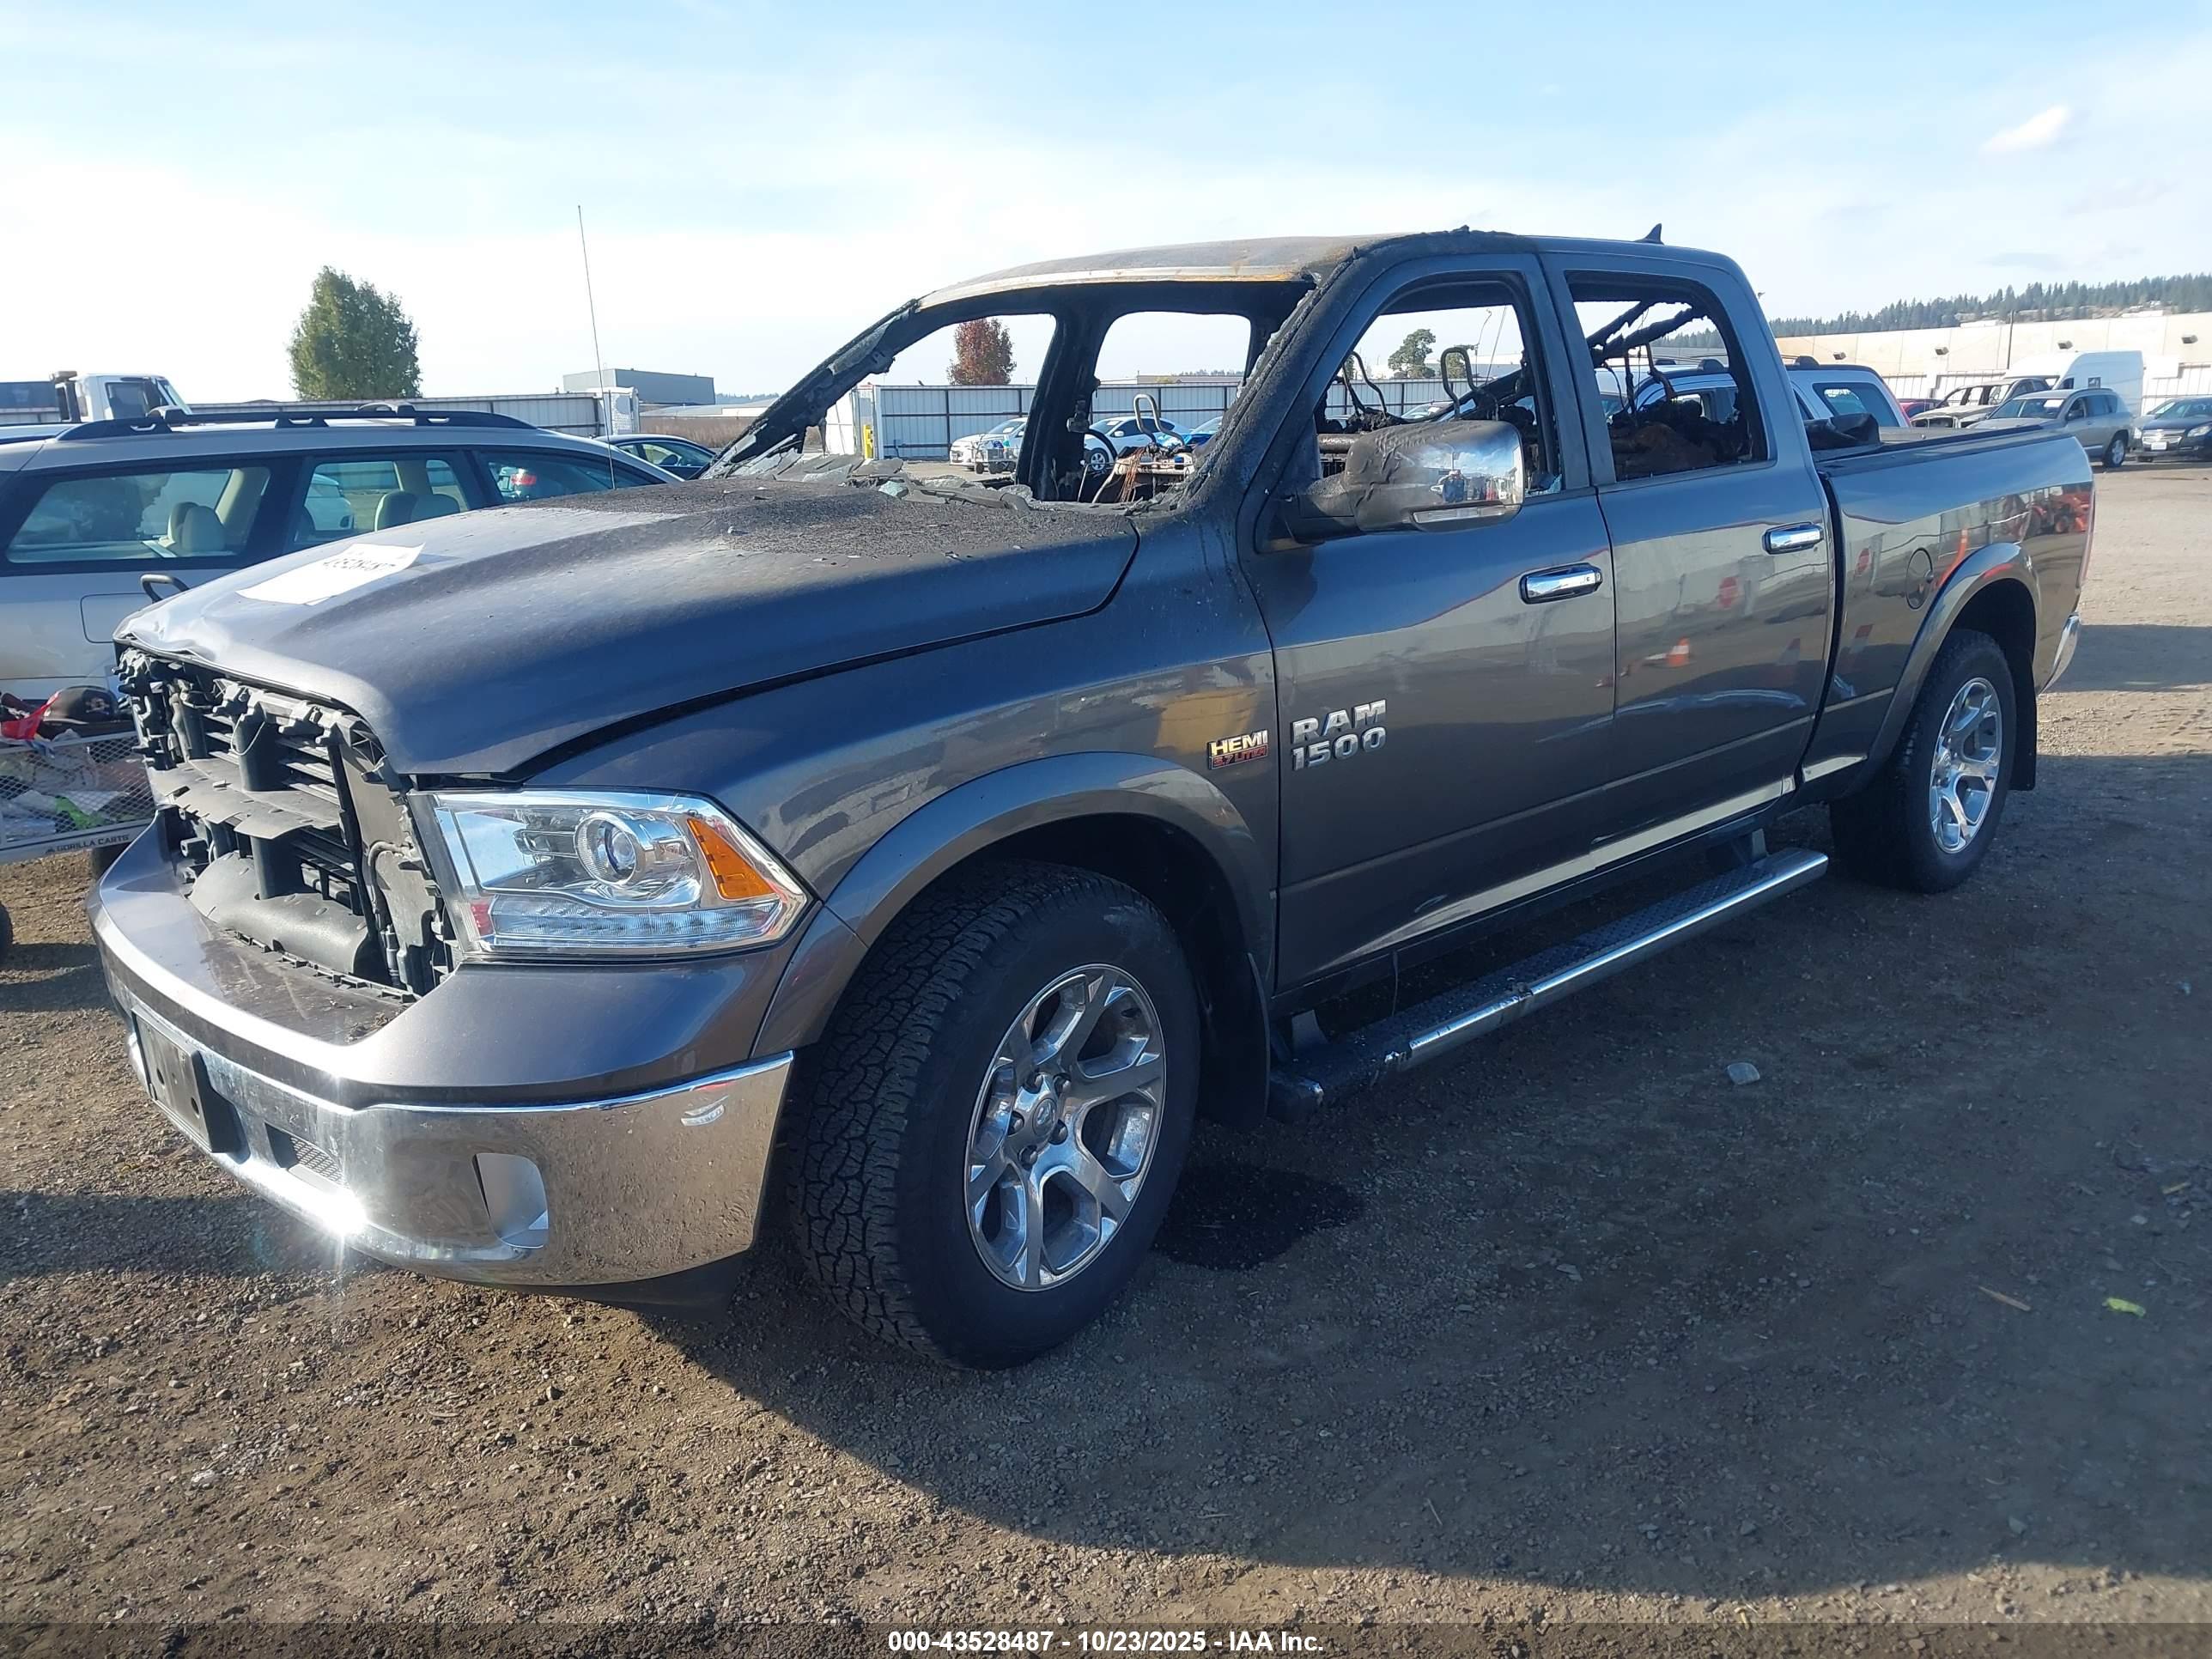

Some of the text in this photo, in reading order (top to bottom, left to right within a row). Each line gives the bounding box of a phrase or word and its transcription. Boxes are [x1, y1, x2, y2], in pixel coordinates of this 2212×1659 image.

[1291, 700, 1386, 744] RAM
[1210, 730, 1267, 756] HEMI
[1291, 726, 1386, 771] 1500
[57, 835, 129, 852] GORILLA CARTS
